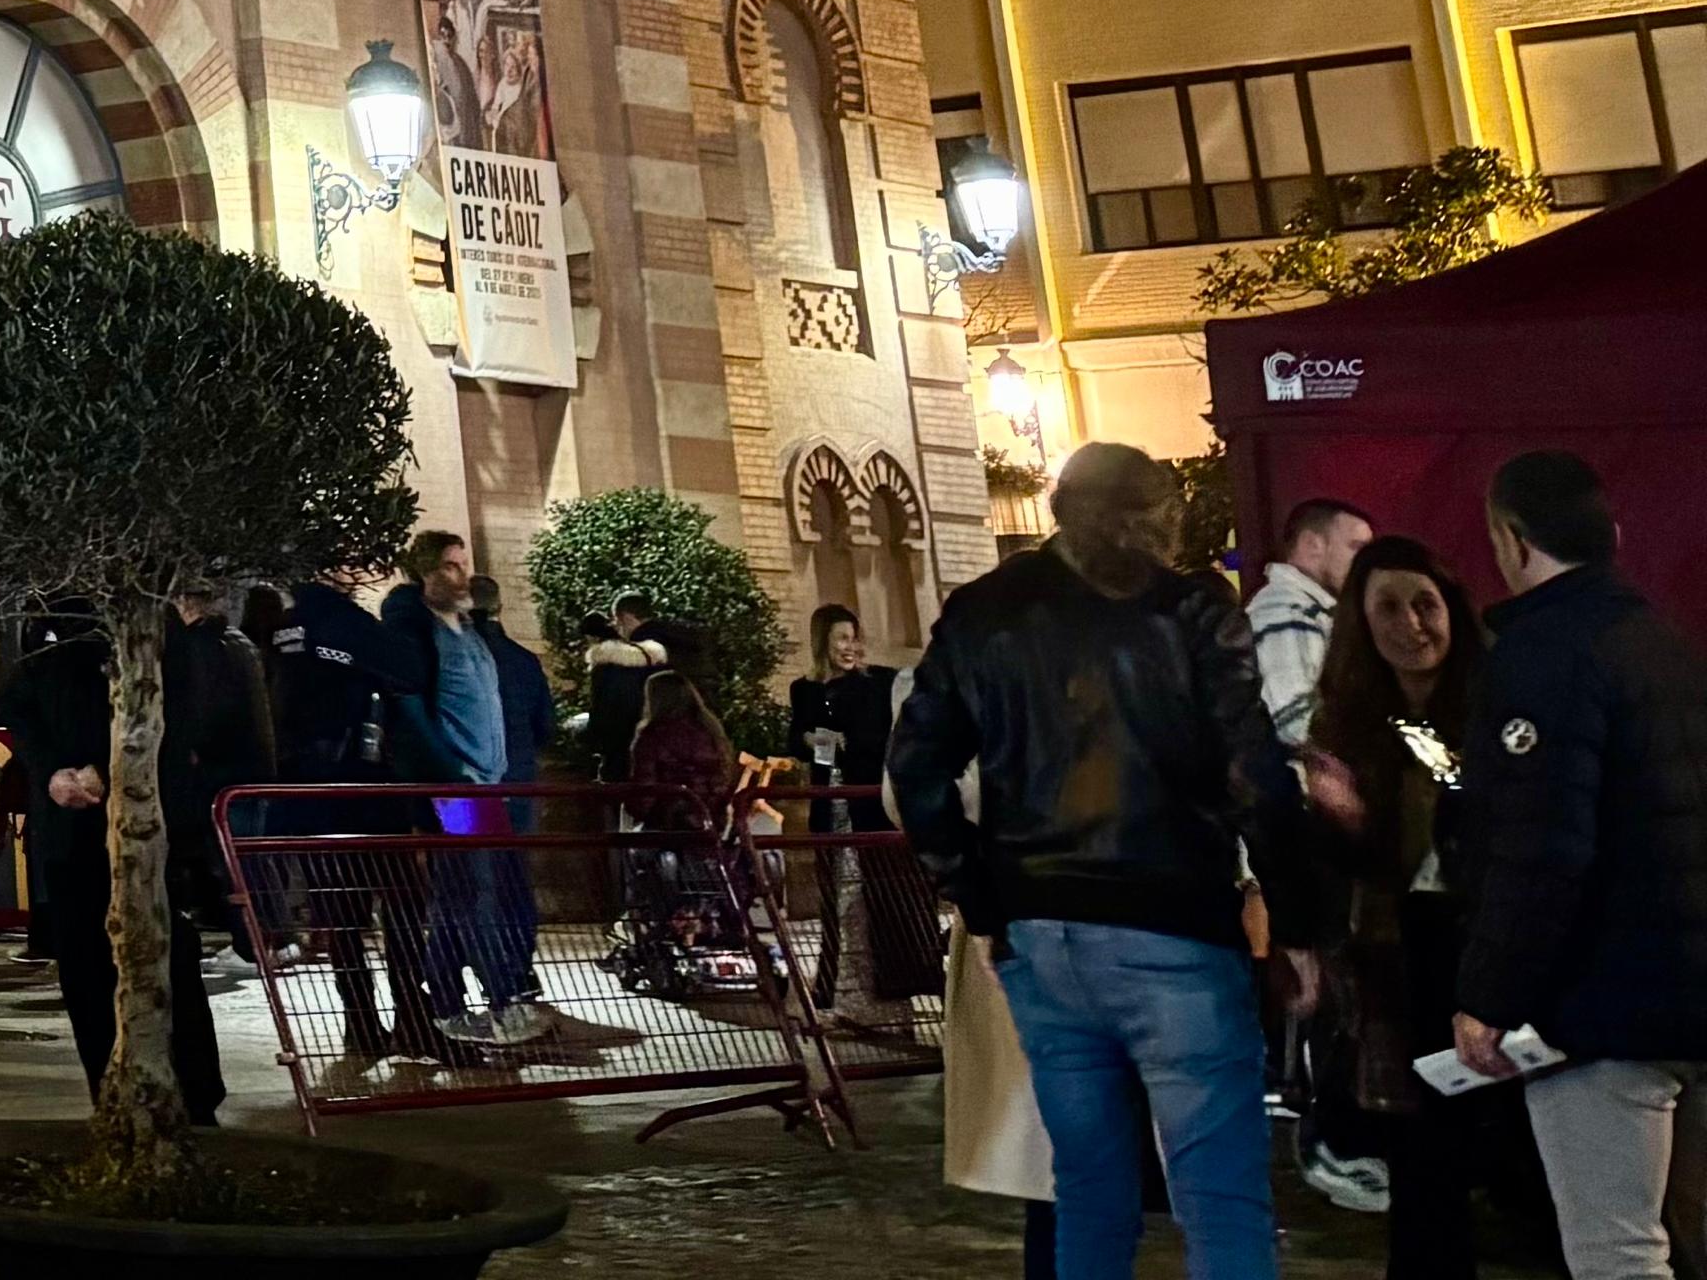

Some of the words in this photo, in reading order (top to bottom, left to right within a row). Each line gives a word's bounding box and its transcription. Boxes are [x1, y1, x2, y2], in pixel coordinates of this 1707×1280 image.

[450, 157, 545, 207] CARNAVAL
[461, 203, 487, 242] DE
[492, 204, 543, 250] CÁDIZ
[1300, 359, 1364, 377] COAC
